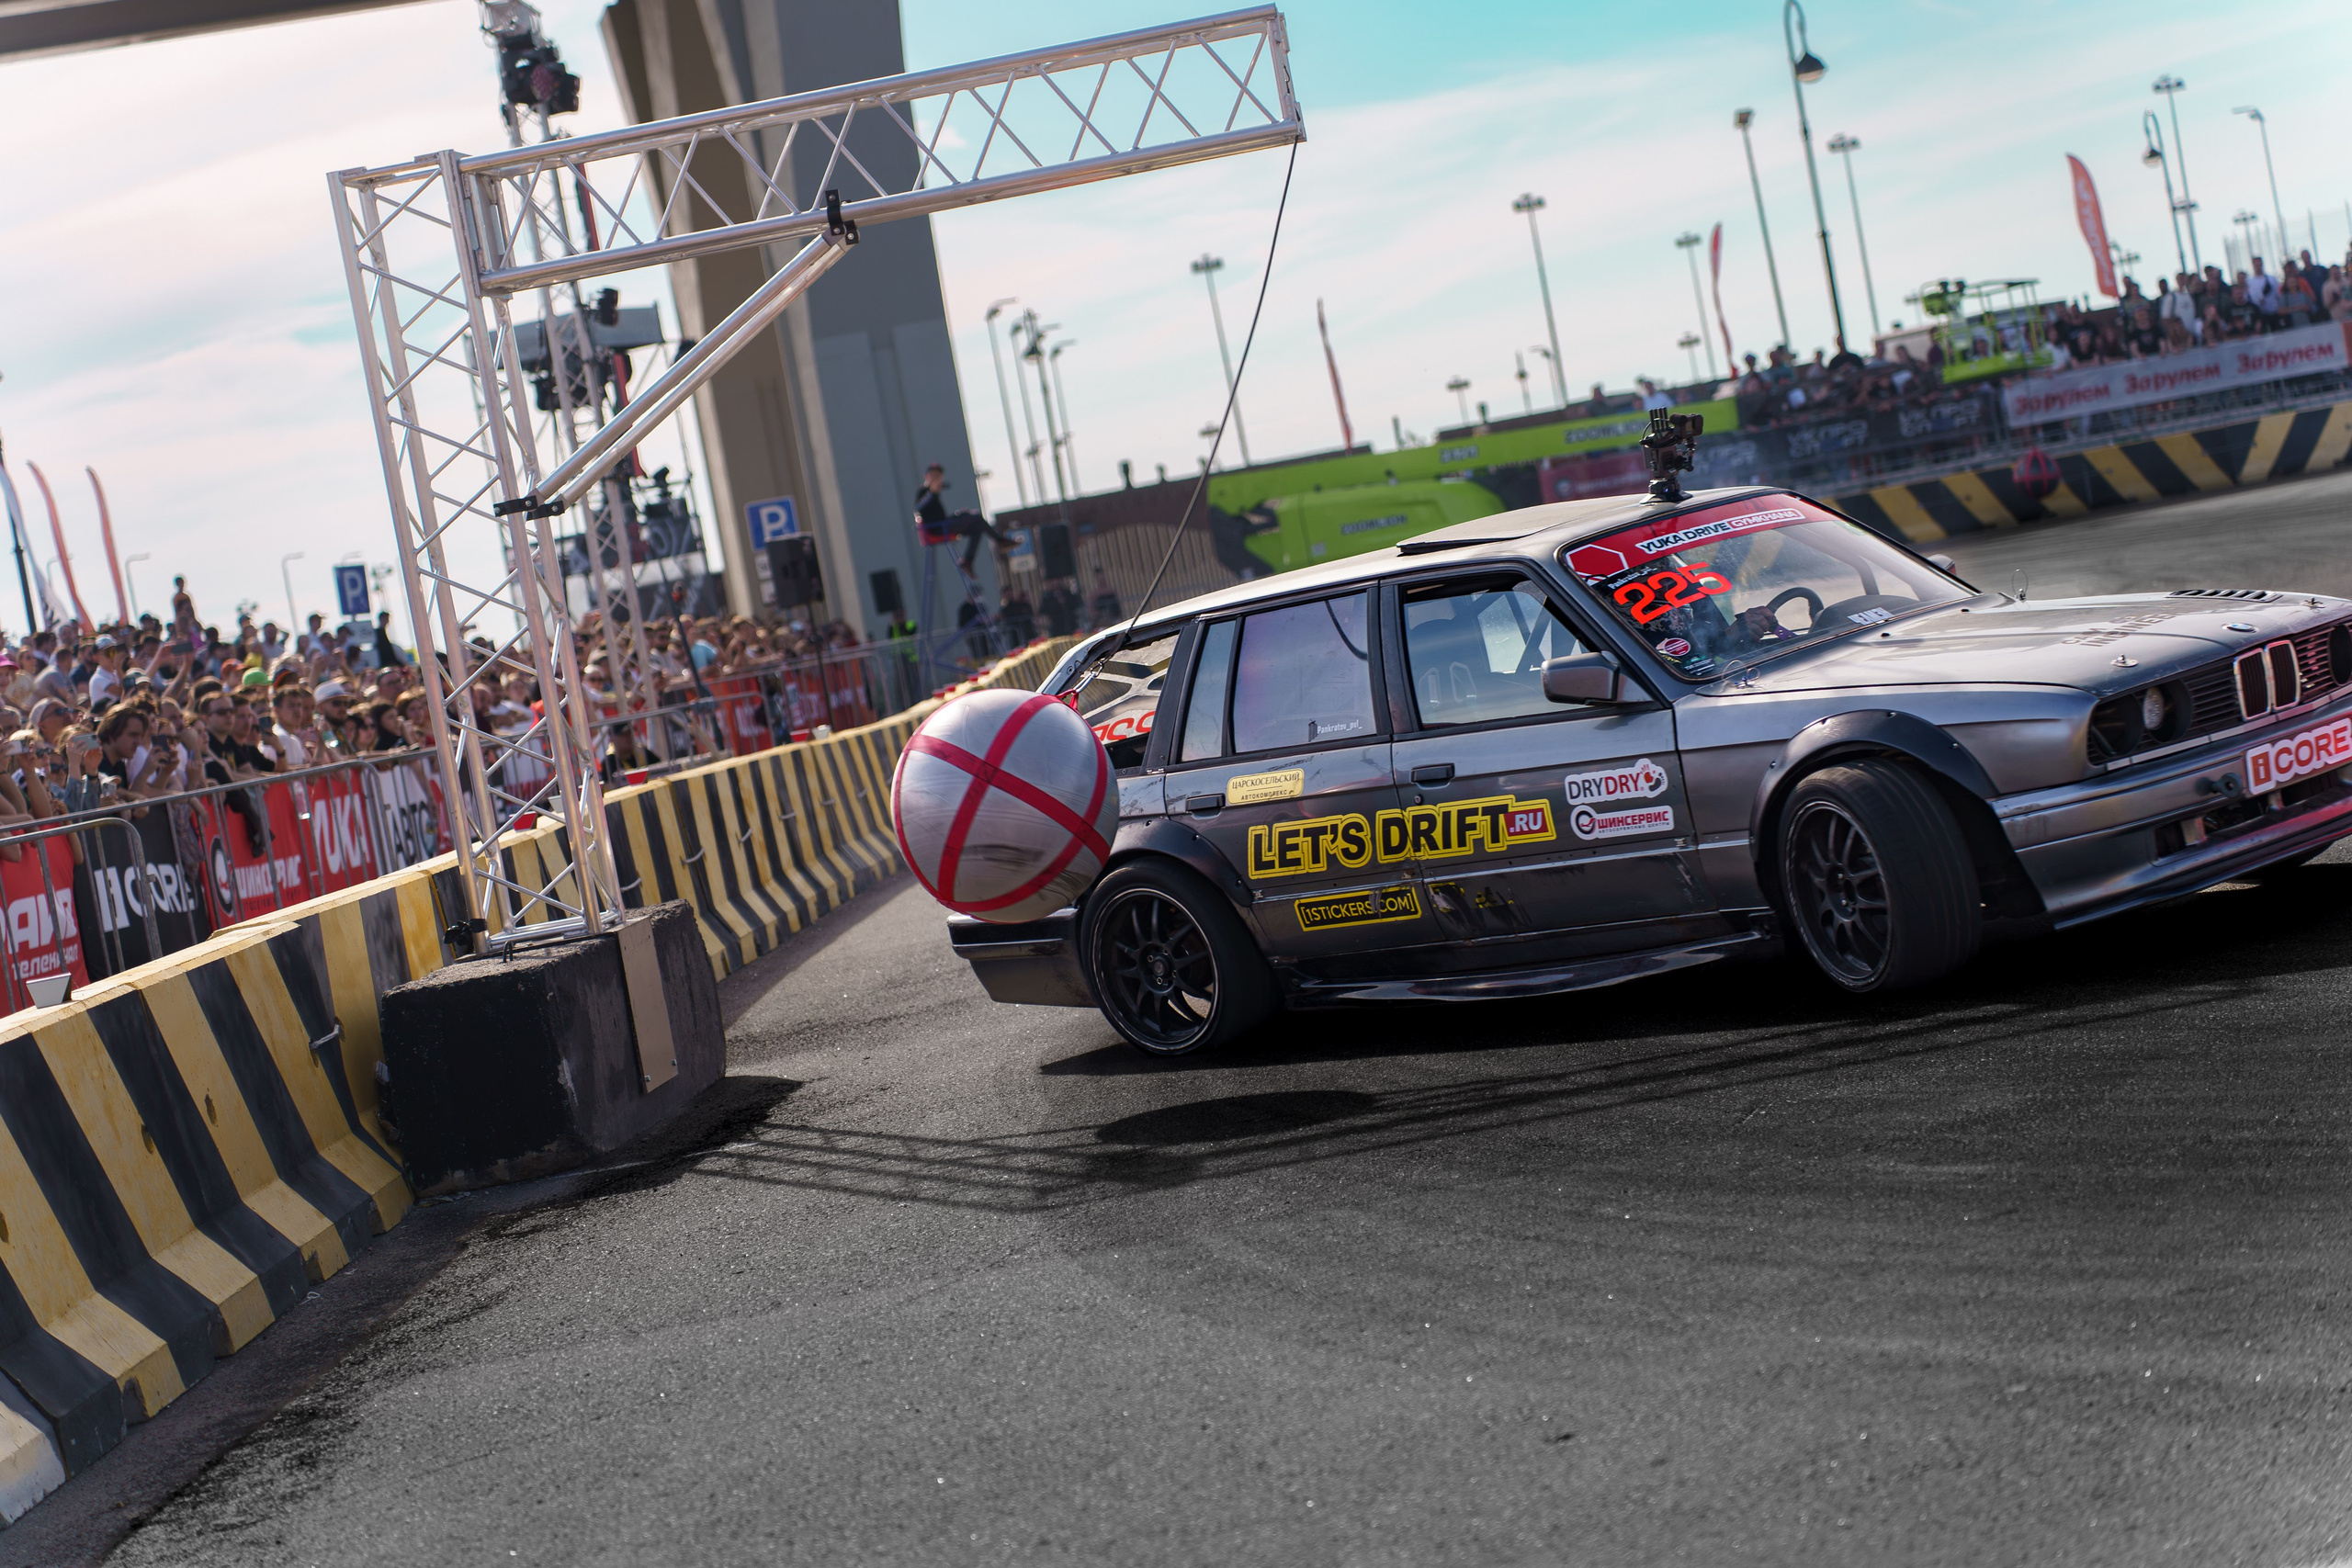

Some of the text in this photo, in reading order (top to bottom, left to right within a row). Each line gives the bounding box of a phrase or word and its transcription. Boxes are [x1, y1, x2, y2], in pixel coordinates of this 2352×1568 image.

[759, 505, 787, 542] P
[1640, 511, 1798, 552] YUKA DRIVE GYMKHANA
[342, 570, 364, 613] P
[1613, 561, 1733, 626] 225
[2251, 725, 2350, 787] iCORE
[1231, 772, 1301, 791] ЦАРСКОСЕЛЬСКИЙ
[1240, 789, 1288, 801] АВТОКОМПЛЕКС
[1567, 772, 1642, 800] DRYDRY
[1597, 810, 1669, 829] ШИНСЕРВИС
[1253, 819, 1368, 872] LET'S
[11, 942, 78, 981] телекнал
